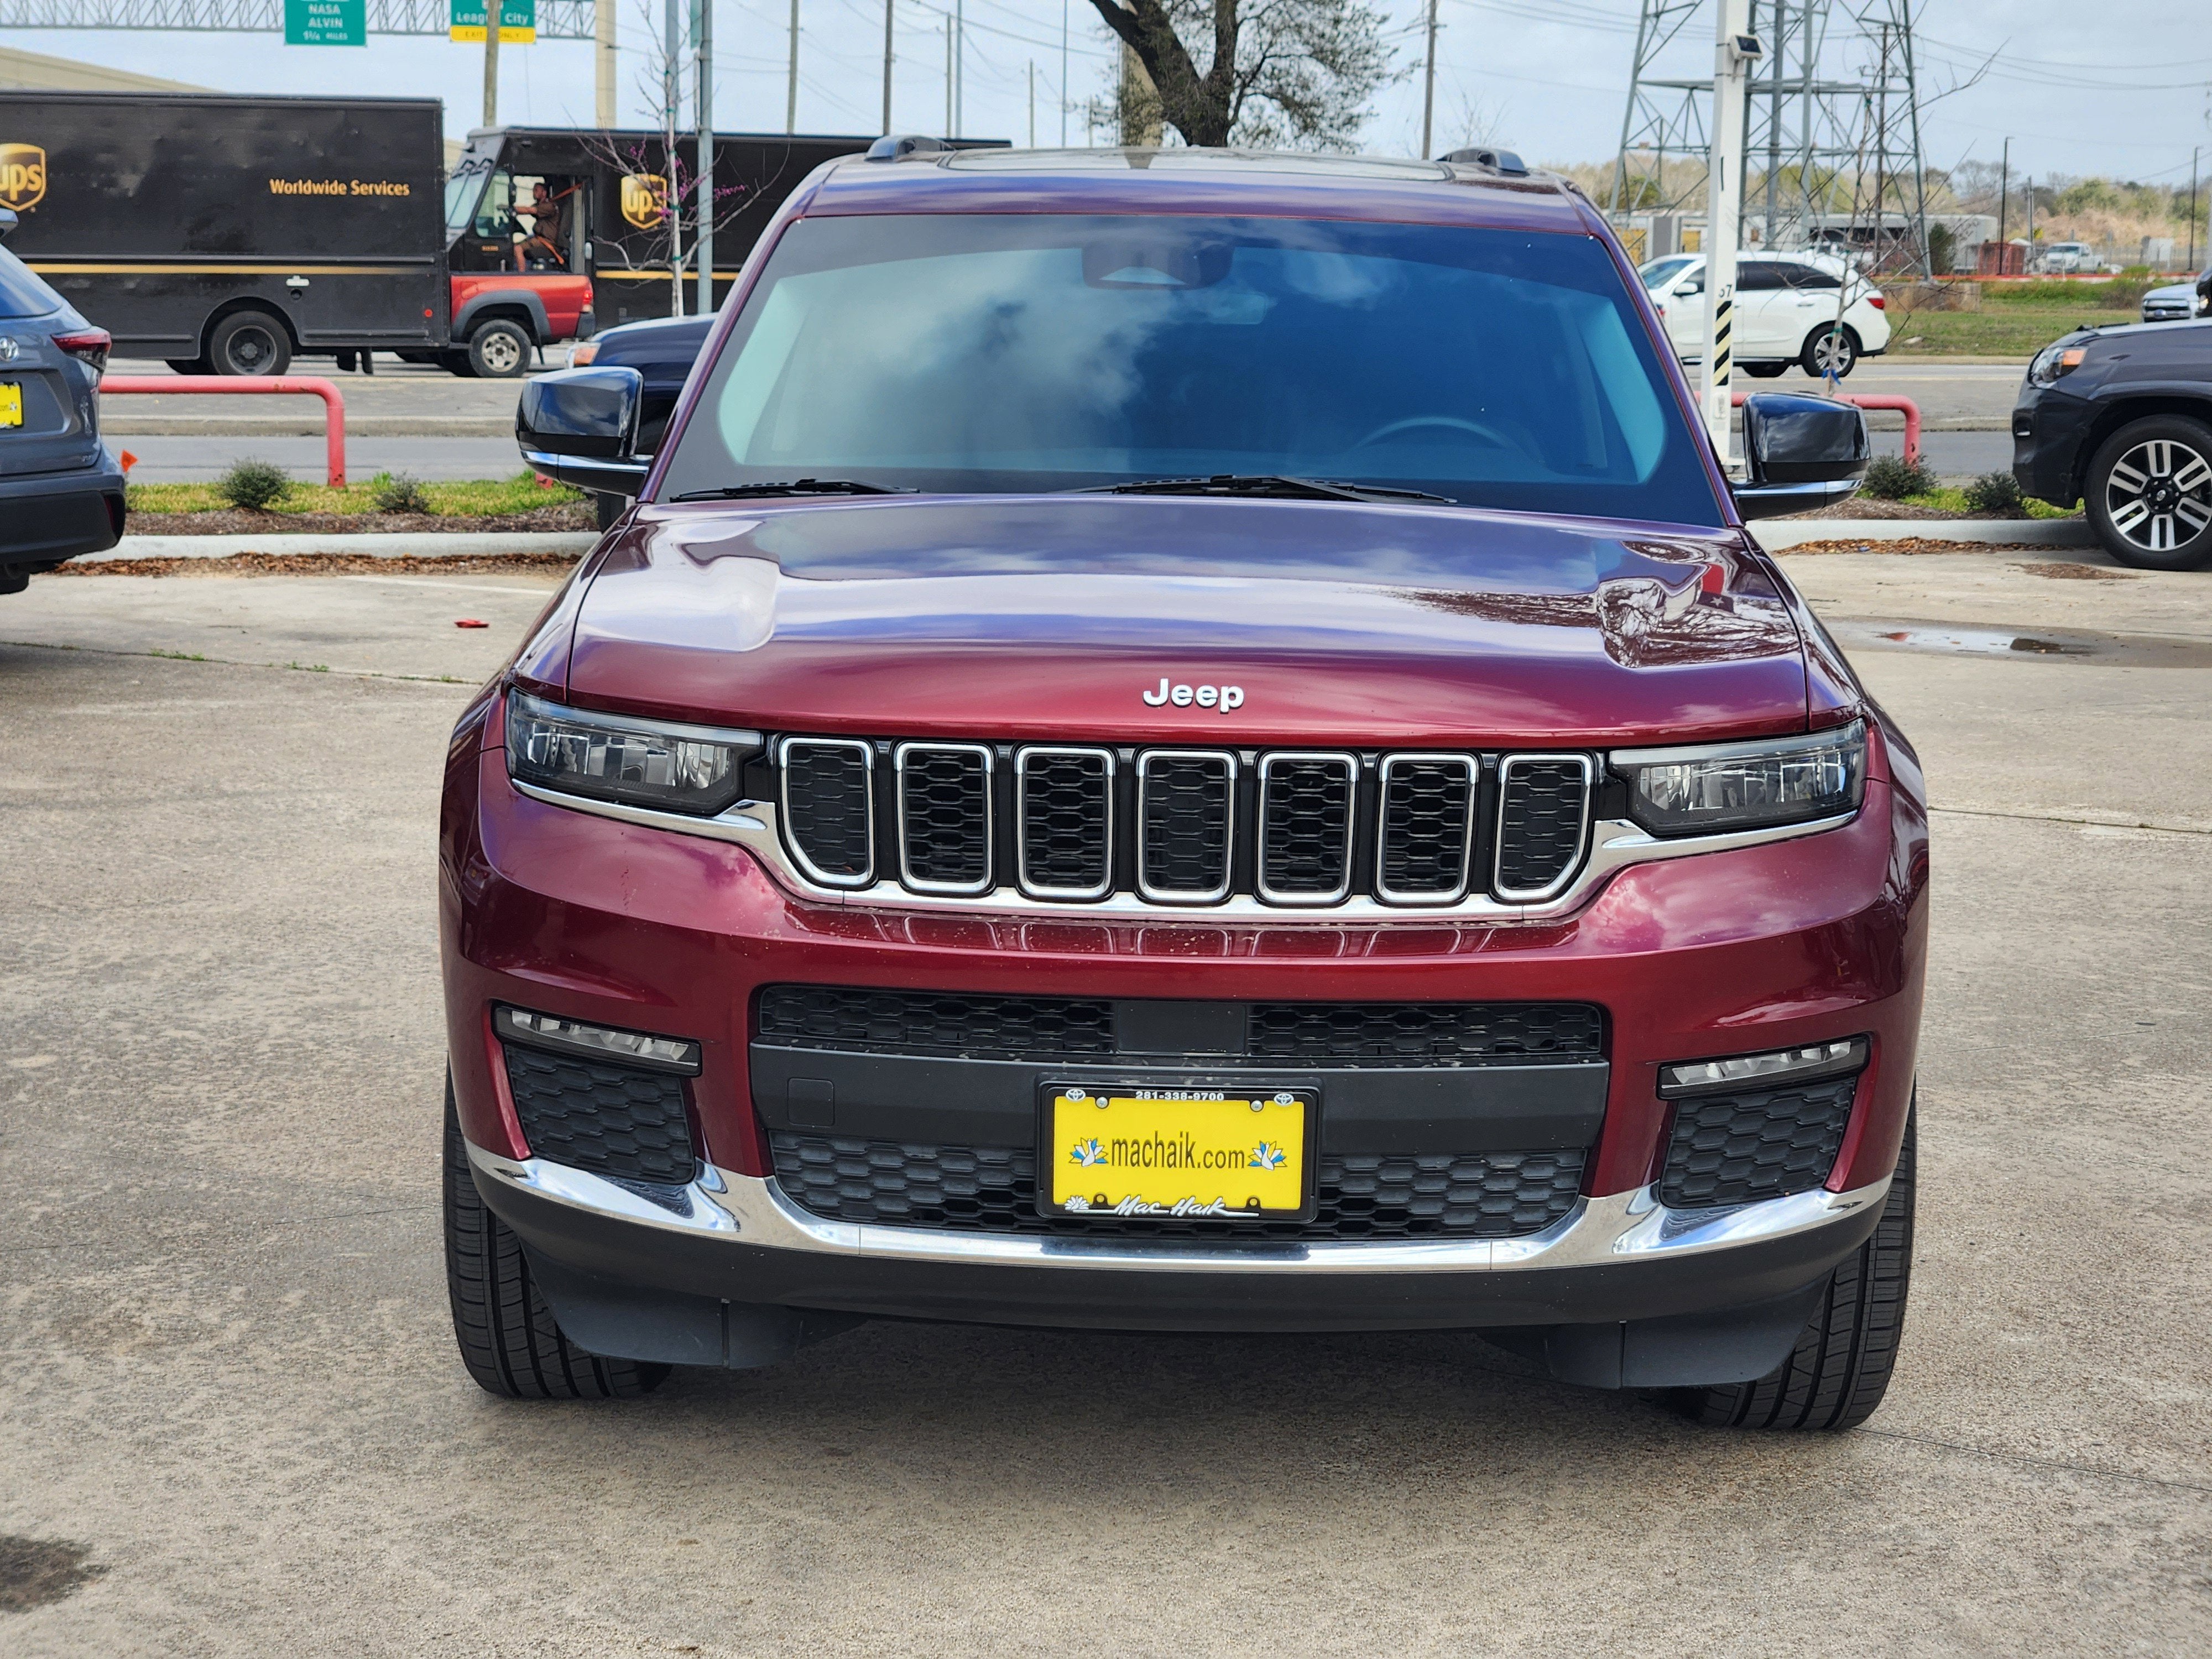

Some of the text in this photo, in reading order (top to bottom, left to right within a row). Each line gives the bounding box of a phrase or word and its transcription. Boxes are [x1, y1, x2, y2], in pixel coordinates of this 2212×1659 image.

[308, 3, 341, 15] NASA
[308, 17, 343, 28] ALVIN
[456, 12, 528, 25] Leag City
[269, 178, 410, 196] Worldwide Services
[1143, 678, 1244, 714] Jeep
[1135, 1091, 1224, 1101] 281-338-9700
[1112, 1131, 1244, 1169] machaik.com
[1112, 1194, 1230, 1217] Mac Haik
